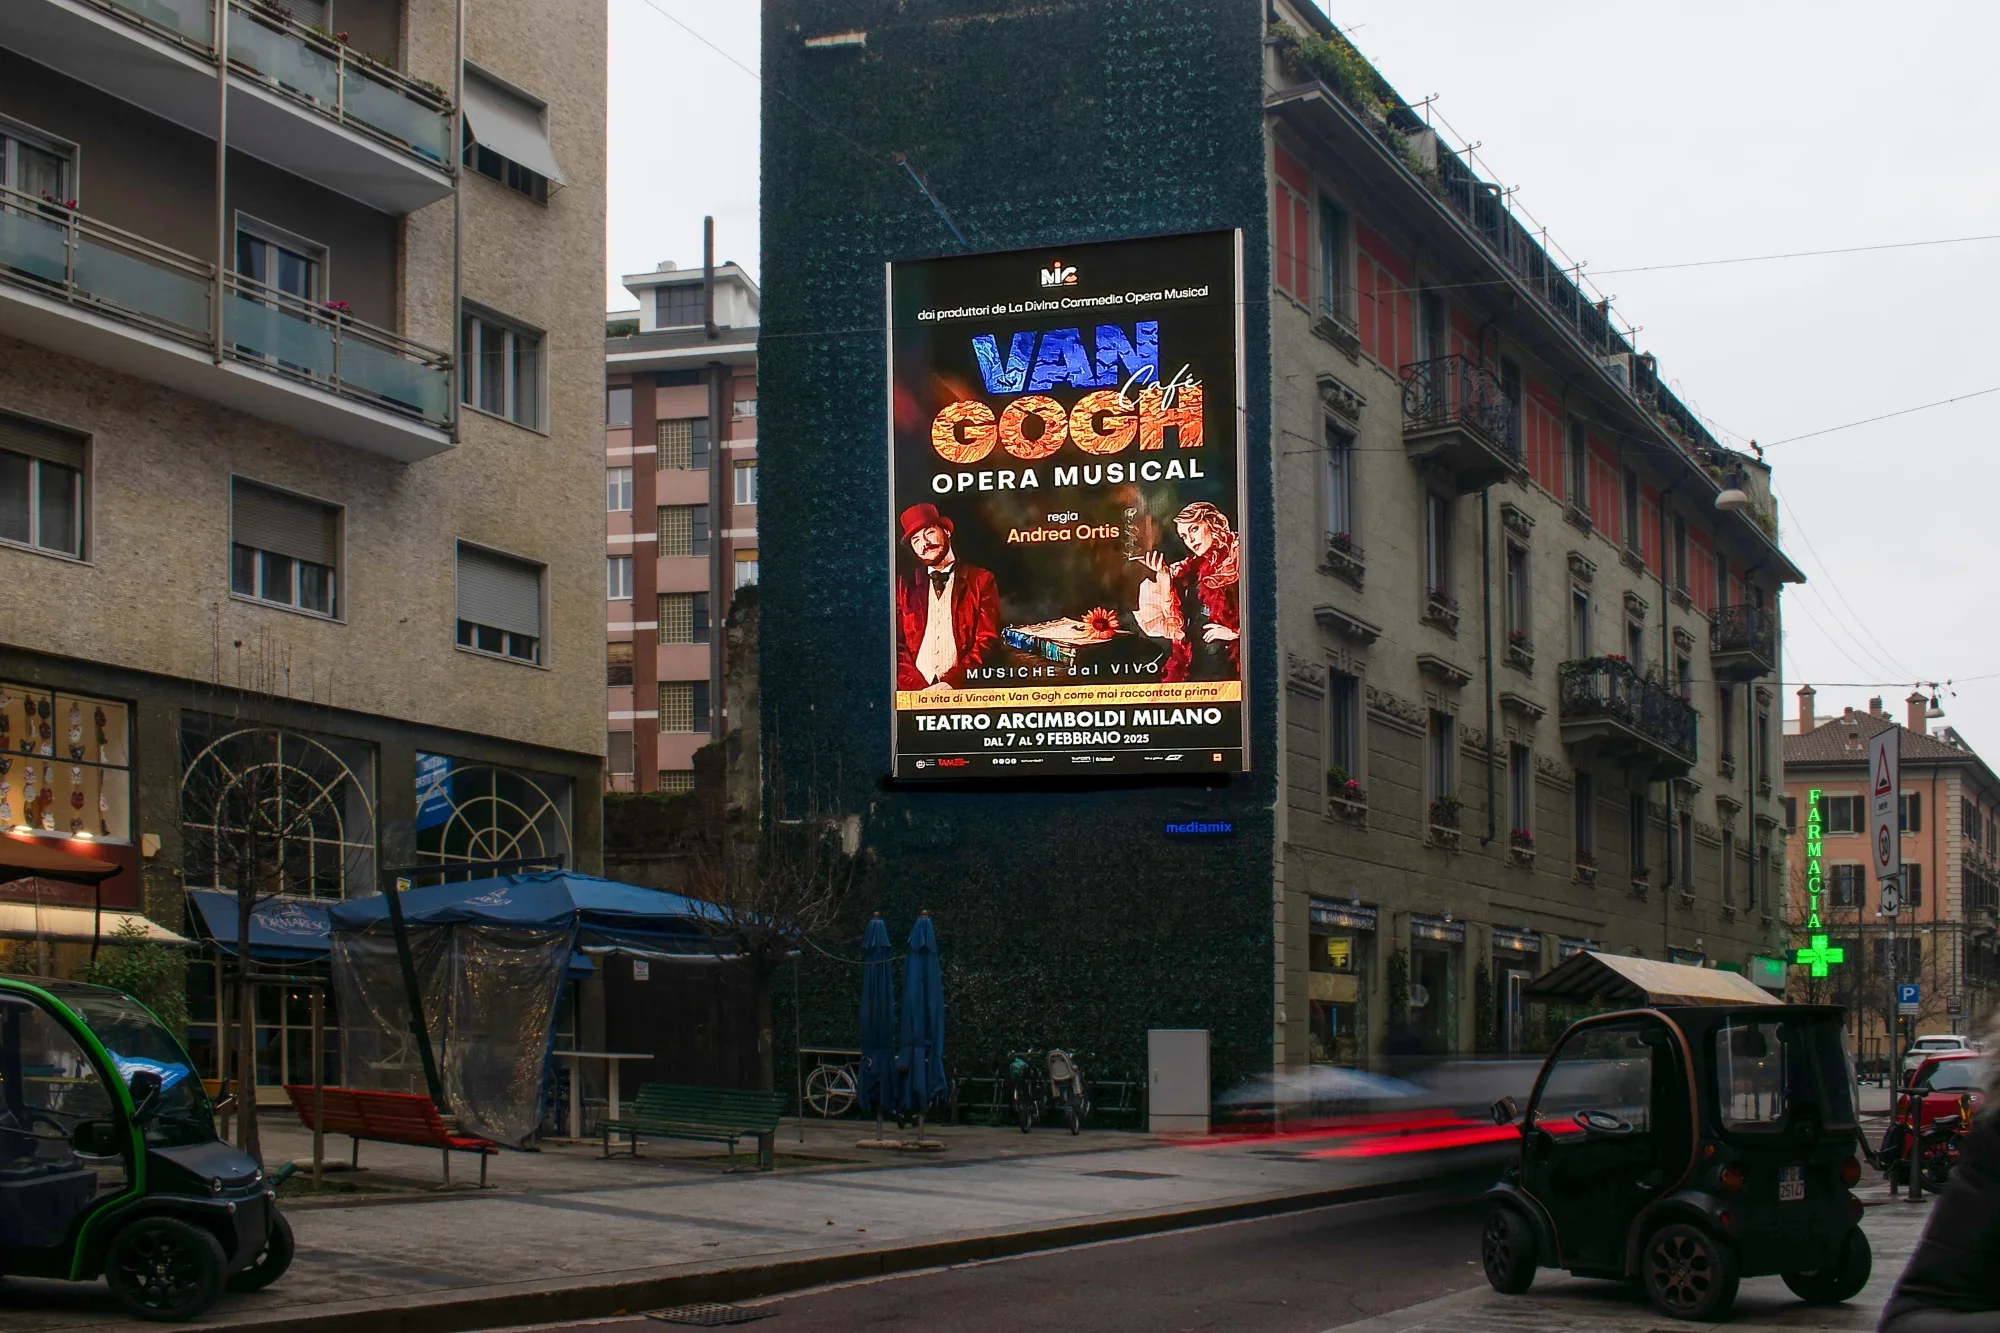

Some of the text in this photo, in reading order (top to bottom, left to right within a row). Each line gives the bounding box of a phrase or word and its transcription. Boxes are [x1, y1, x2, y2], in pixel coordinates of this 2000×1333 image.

[918, 285, 1209, 321] dai produttori de La Divina Commedia Opera Musical
[971, 320, 1158, 394] VAN
[1119, 363, 1202, 411] Café
[930, 385, 1205, 464] GOGH
[931, 458, 1205, 494] OPERA MUSICAL
[1047, 510, 1079, 525] regia
[1007, 524, 1120, 543] Andrea Ortis
[966, 662, 1158, 680] MUSICHE dal VIVO
[918, 686, 1218, 704] la vita di Vincent Van Gogh come mai raccontata prima
[915, 707, 1222, 732] TEATRO ARCIMBOLDI MILANO
[983, 731, 1150, 747] DAL 7 AL 9 FEBBRAIO 2025
[1166, 821, 1232, 833] mediamix
[1807, 789, 1822, 928] FARMACIA
[252, 914, 330, 931] TORMARESC
[1903, 987, 1915, 1001] P
